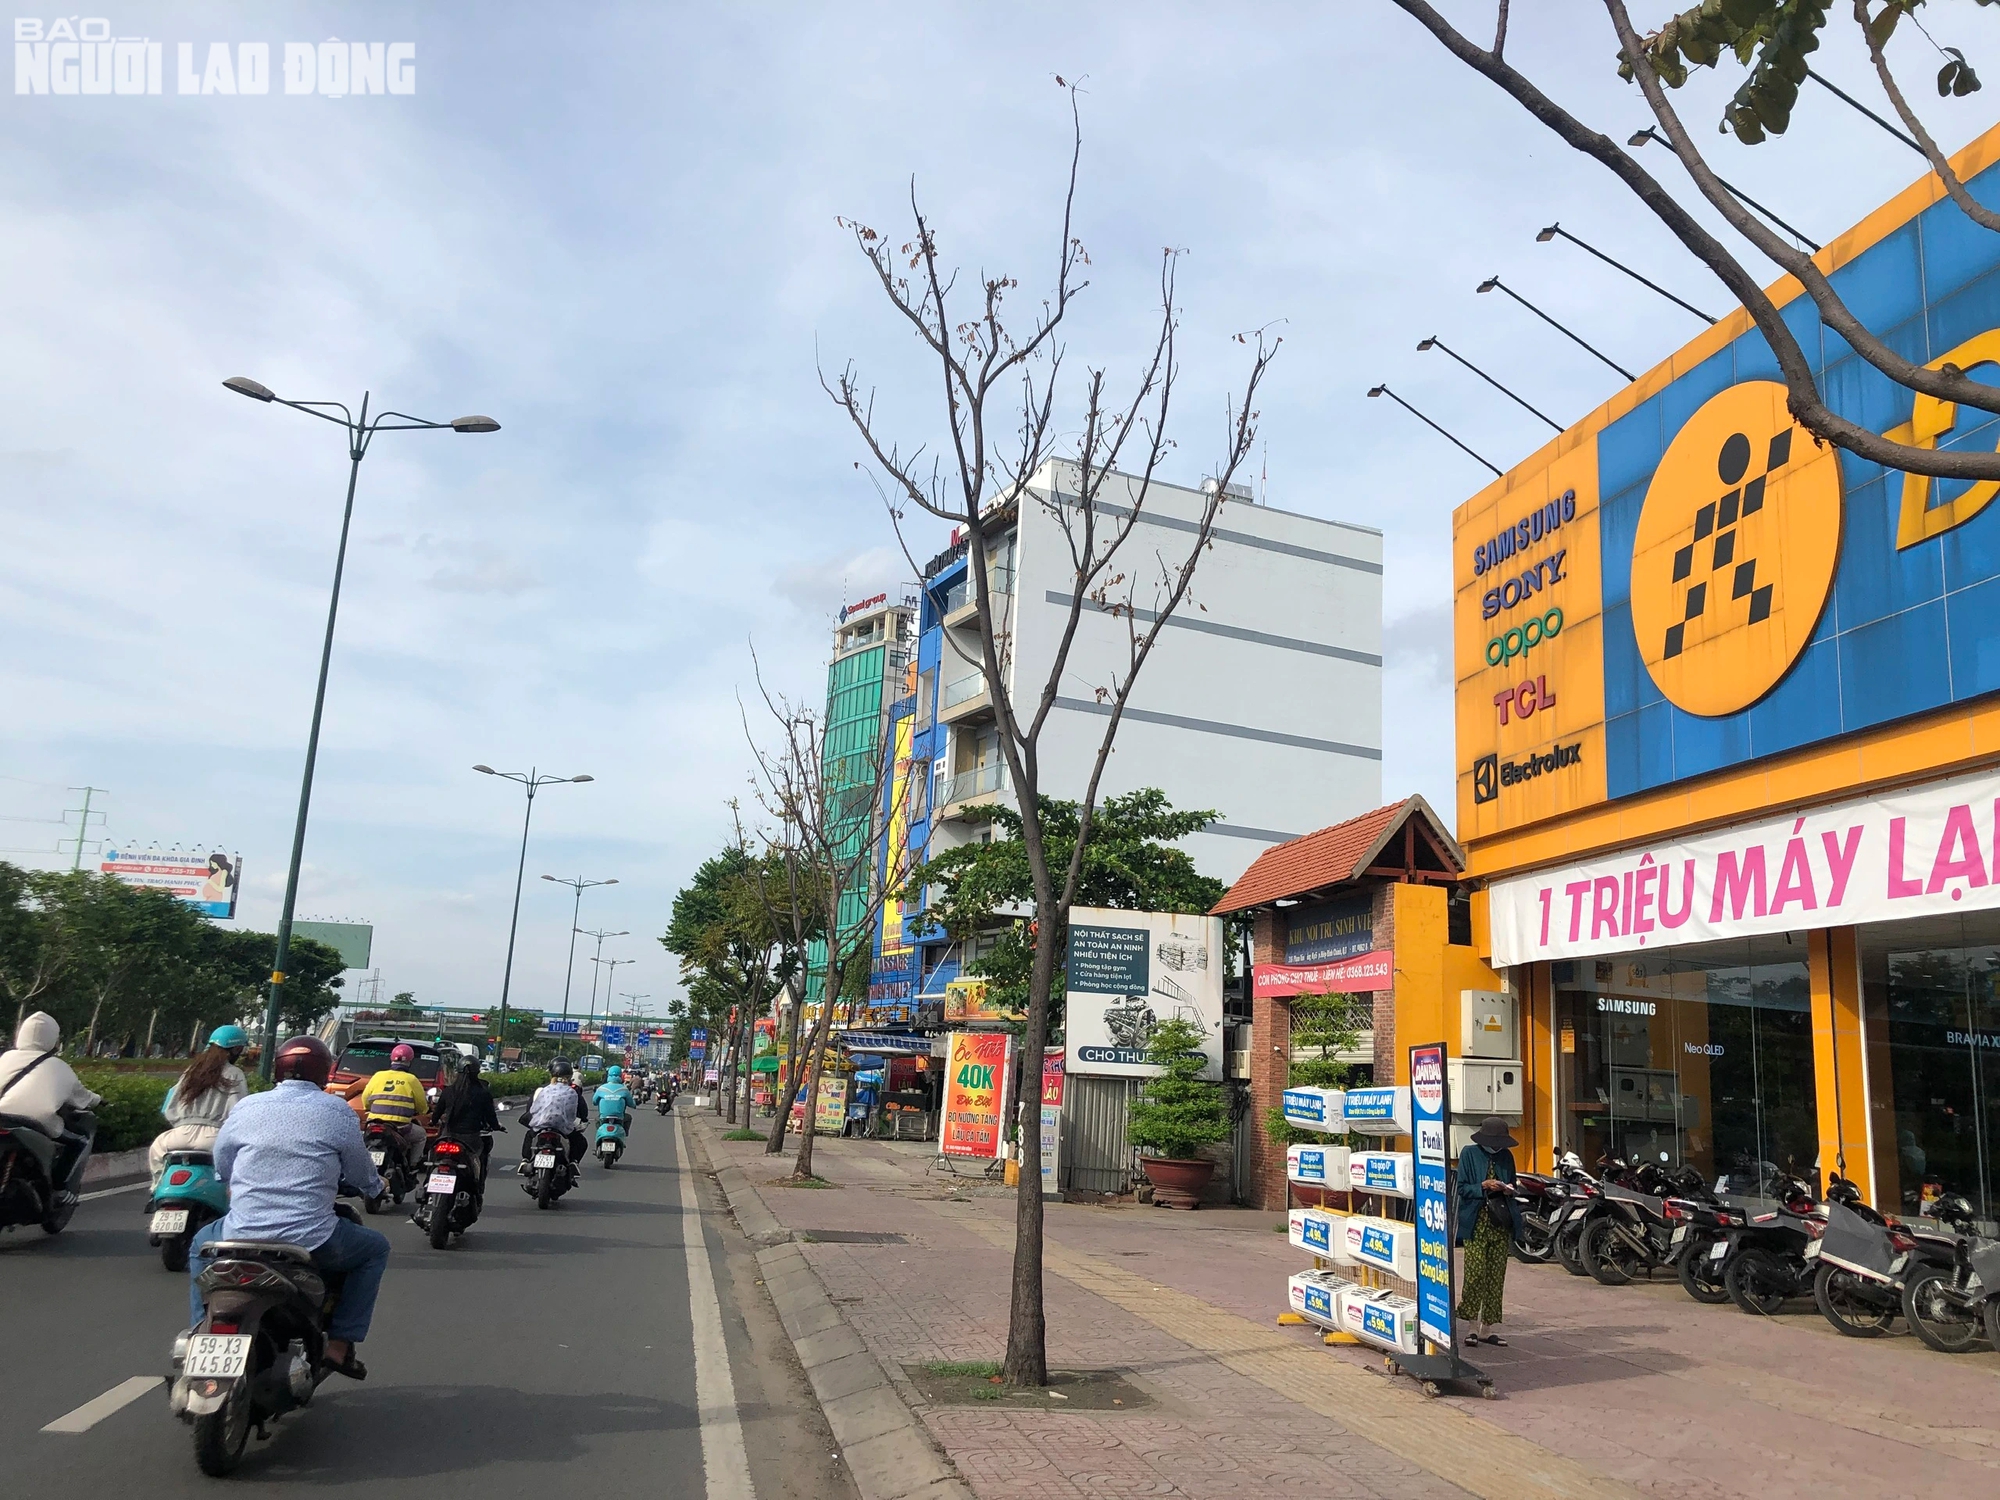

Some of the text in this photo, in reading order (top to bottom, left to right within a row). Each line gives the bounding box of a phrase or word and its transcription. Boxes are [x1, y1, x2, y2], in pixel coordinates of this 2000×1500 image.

[1474, 489, 1576, 576] SAMSUNG
[1493, 675, 1556, 725] TCL
[1500, 742, 1581, 788] Electrolux
[1539, 797, 2000, 947] 1 TRIỆU MÁY LẠ
[1074, 930, 1088, 938] NỘI
[1112, 933, 1133, 942] SẠCH
[1289, 928, 1305, 945] KHU
[1335, 916, 1355, 937] SINH
[1087, 941, 1109, 949] TOÀN
[1100, 952, 1117, 961] TIỆN
[1119, 953, 1132, 961] ÍCH
[1258, 972, 1270, 986] CÒN
[1270, 970, 1290, 986] PHÒNG
[1290, 972, 1303, 984] CHO
[1303, 967, 1319, 983] THUÊ
[1322, 965, 1335, 980] LIÊN
[1347, 963, 1388, 979] 0368.123.543
[1598, 998, 1656, 1016] SAMSUNG
[1946, 1031, 1990, 1047] BRAVIA
[1085, 1049, 1116, 1062] CHO
[1684, 1042, 1724, 1056] Neo QLED
[957, 1064, 996, 1090] 40K
[1348, 1093, 1363, 1107] TRIỆU
[1363, 1093, 1377, 1106] MÁY
[1377, 1094, 1392, 1107] LẠNH
[1424, 1198, 1445, 1232] 6,99
[1369, 1238, 1383, 1253] 4,99
[1420, 1238, 1432, 1255] Bao
[1420, 1258, 1435, 1284] Công
[1371, 1316, 1385, 1332] 5,99
[199, 1338, 242, 1354] 59-X3
[190, 1356, 244, 1374] 145.87
